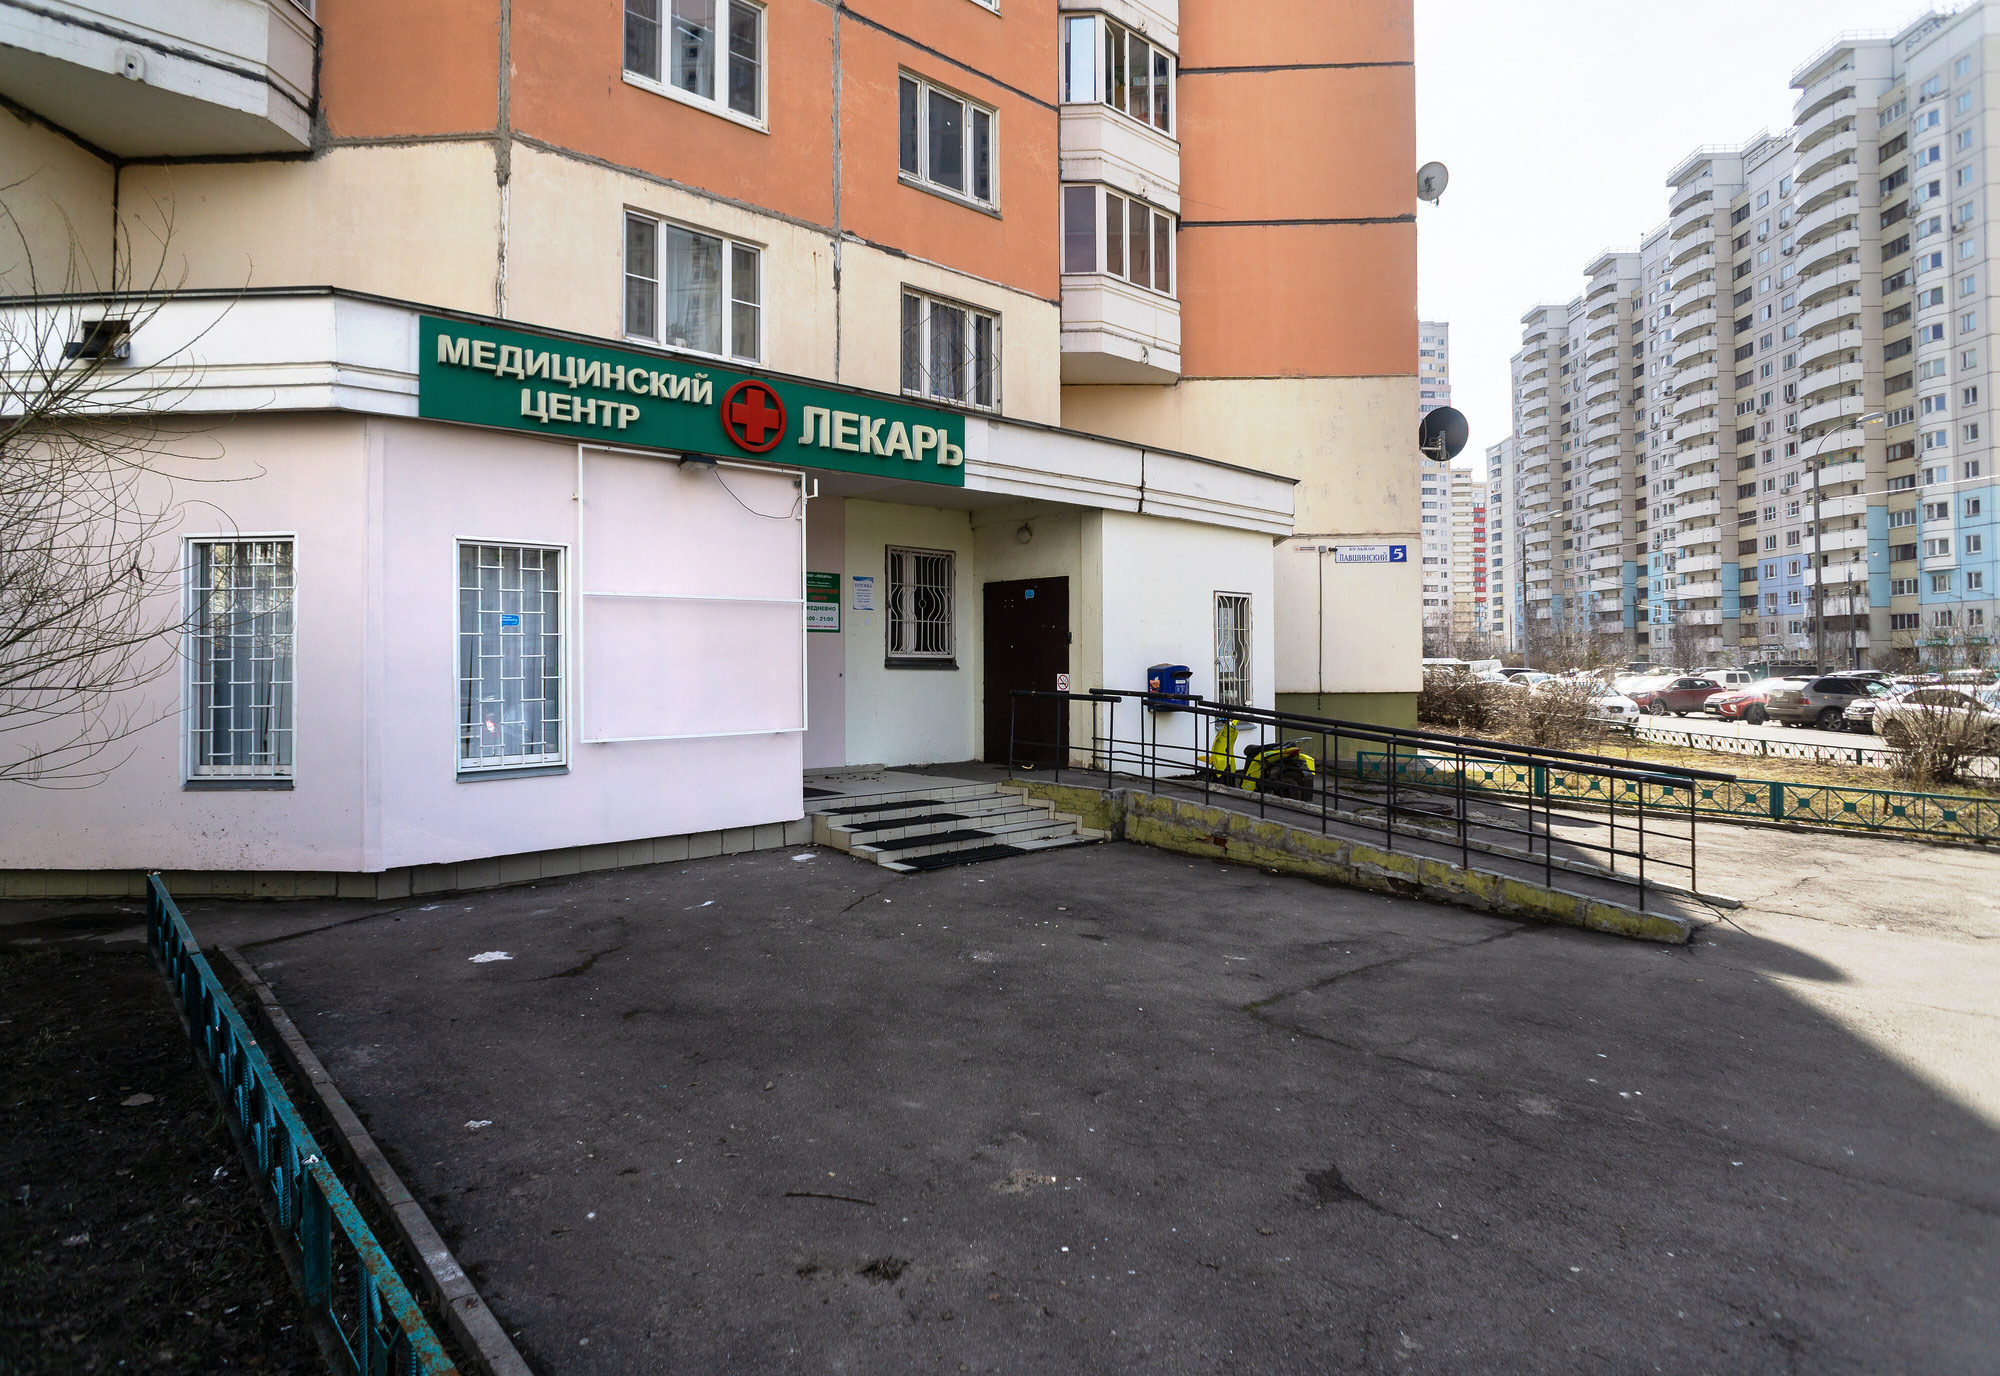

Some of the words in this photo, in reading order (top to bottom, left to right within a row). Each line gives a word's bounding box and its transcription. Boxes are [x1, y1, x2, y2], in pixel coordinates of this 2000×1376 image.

[437, 333, 713, 406] МЕДИЦИНСКИЙ
[520, 388, 641, 430] ЦЕНТР
[798, 404, 964, 467] ЛЕКАРЬ
[1339, 552, 1388, 562] ПАВШИНСКИЙ
[1393, 548, 1404, 560] 5
